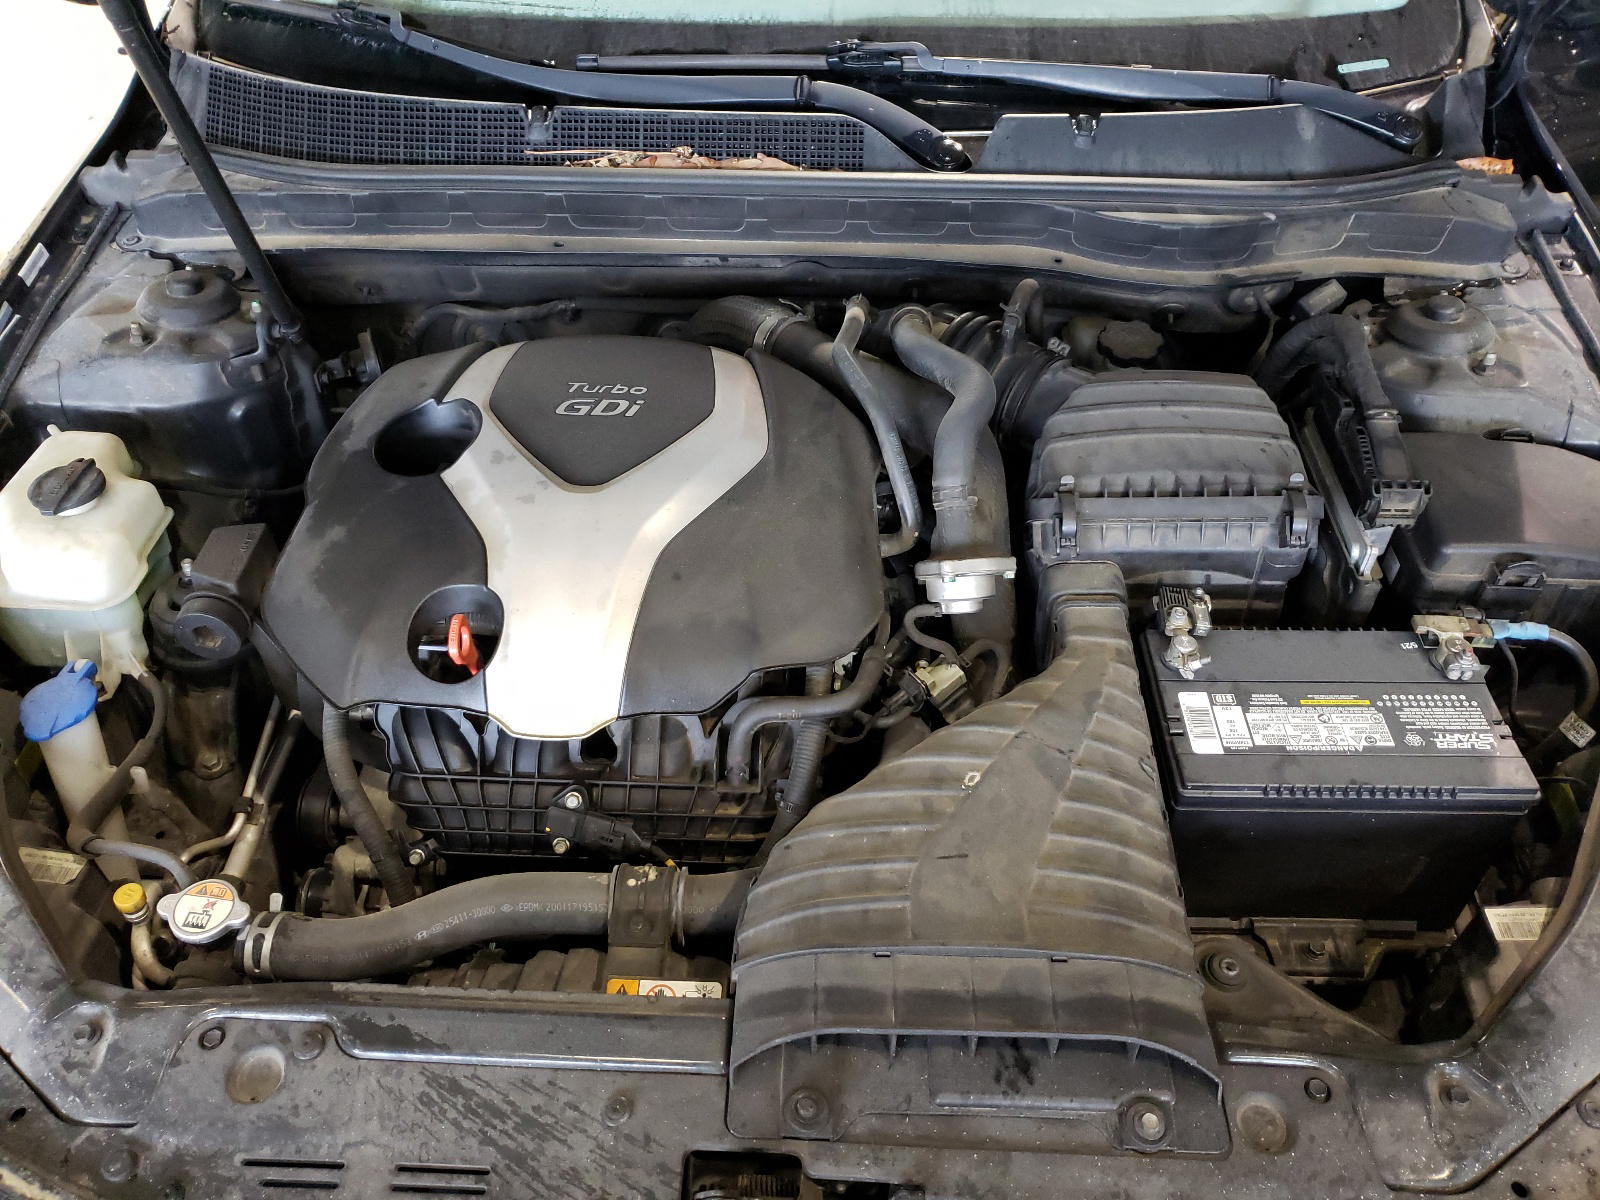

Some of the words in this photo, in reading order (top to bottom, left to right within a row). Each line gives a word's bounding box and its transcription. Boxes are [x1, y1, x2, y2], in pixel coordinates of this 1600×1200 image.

[568, 382, 648, 395] Turbo
[555, 398, 646, 417] GDi
[1215, 694, 1233, 703] STD
[1434, 733, 1494, 742] START
[1436, 741, 1491, 750] SUPER
